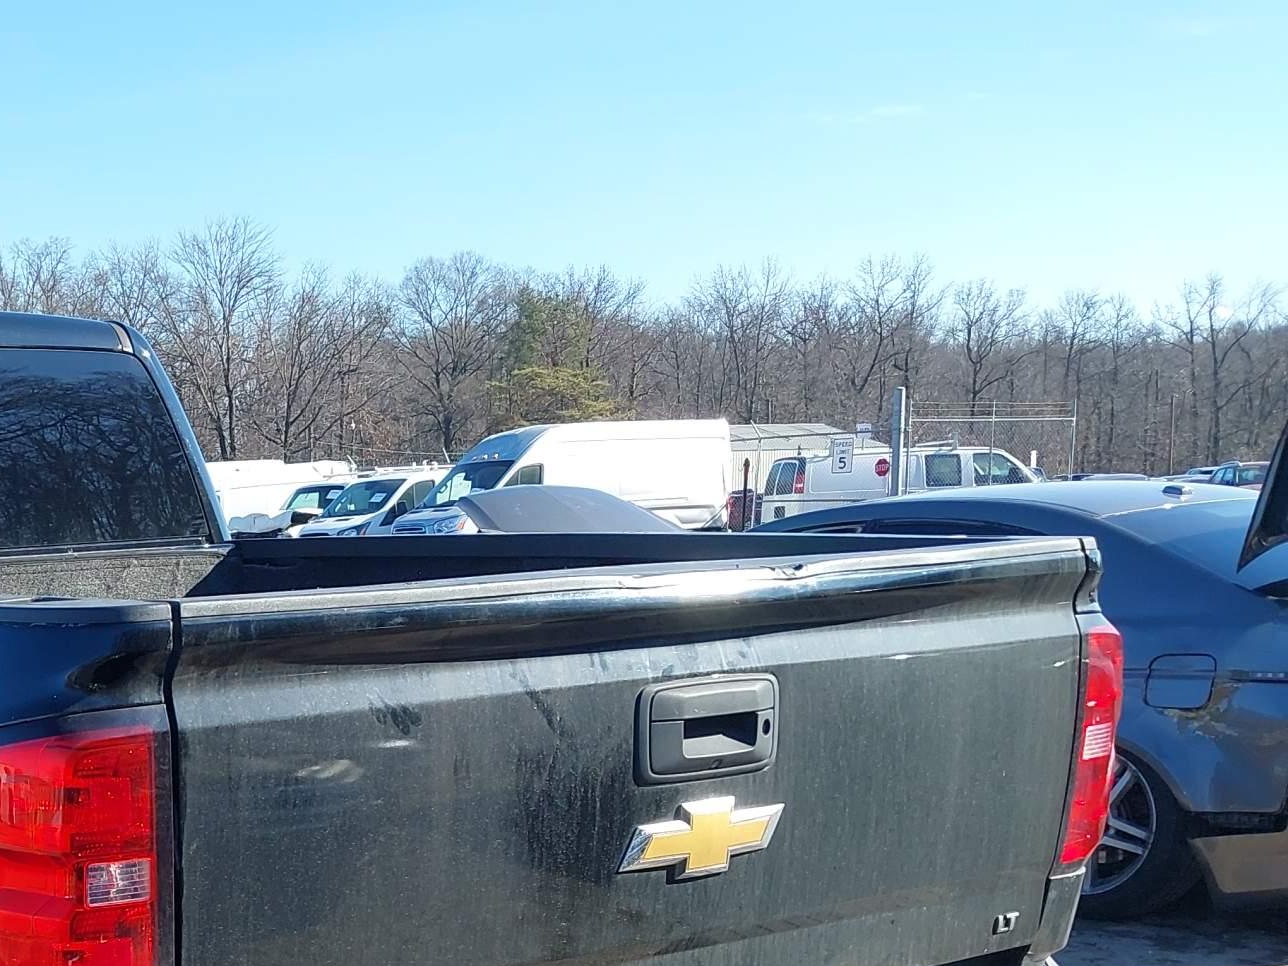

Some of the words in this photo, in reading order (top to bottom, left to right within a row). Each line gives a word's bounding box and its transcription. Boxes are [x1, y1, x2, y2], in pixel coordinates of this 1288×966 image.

[838, 457, 847, 469] 5
[876, 464, 889, 473] STOP
[993, 912, 1020, 934] LT
